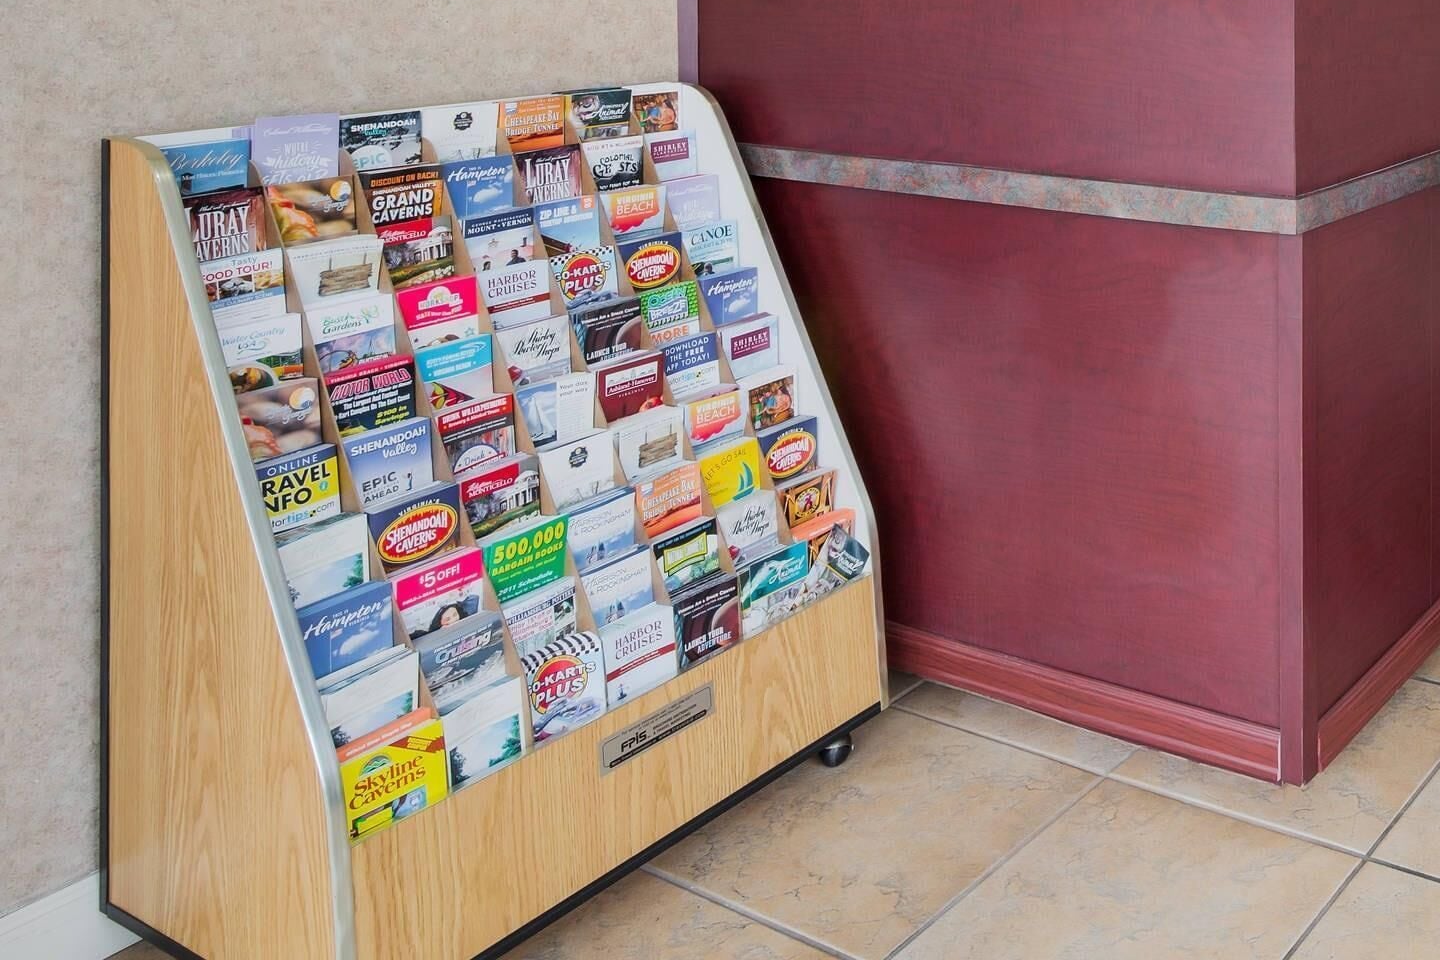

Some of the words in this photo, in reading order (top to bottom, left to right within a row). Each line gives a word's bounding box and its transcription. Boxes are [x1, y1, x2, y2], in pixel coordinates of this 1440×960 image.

[351, 118, 417, 133] SHENANDOAH
[547, 110, 560, 123] BAY
[447, 166, 505, 183] Hampton
[525, 158, 571, 188] LURAY
[372, 189, 434, 211] GRAND
[616, 200, 654, 215] BEACH
[371, 203, 433, 224] CAVERNS
[467, 224, 497, 235] MOUNT
[501, 216, 532, 228] VERNON
[690, 224, 733, 246] CANOE
[196, 234, 249, 262] AVERNS
[231, 255, 258, 267] Tasty
[236, 261, 273, 276] TOUR!
[630, 251, 674, 276] SHENANDOAH
[488, 270, 537, 288] HARBOR
[636, 264, 666, 280] CAVERNS
[488, 279, 537, 299] CRUISES
[564, 275, 604, 294] PLUS
[708, 278, 753, 296] Hampton
[322, 319, 362, 335] Gardens
[651, 325, 689, 345] MORE
[665, 336, 710, 357] DOWNLOAD
[669, 352, 683, 363] THE
[685, 345, 705, 359] FREE
[665, 362, 680, 373] APP
[681, 353, 710, 368] TODAY!
[330, 377, 370, 401] MOTOR
[372, 368, 412, 390] WORLD
[696, 404, 736, 424] BEACH
[351, 425, 427, 457] SHENANDOAH
[383, 441, 418, 459] Valley
[720, 454, 733, 466] GO
[769, 438, 809, 467] SHENANDOAH
[775, 452, 802, 470] CAVERNS
[267, 453, 319, 477] ONLINE
[262, 463, 331, 497] RAVEL
[362, 471, 398, 493] EPIC
[468, 478, 513, 499] MONTICELLO
[681, 479, 696, 492] BAY
[264, 487, 313, 513] NFO
[363, 485, 400, 504] AHEAD
[385, 510, 448, 551] SHENANDOAH
[395, 529, 437, 554] CAVERNS
[492, 520, 565, 565] 500,000
[491, 554, 533, 577] BARGAIN
[535, 541, 563, 560] BOOKS
[418, 570, 436, 588] $5
[437, 562, 461, 581] OFF!
[303, 601, 384, 641] Hampton
[615, 620, 663, 650] HARBOR
[615, 630, 663, 661] CRUISES
[684, 634, 707, 653] LAUNCH
[707, 626, 724, 641] YOUR
[697, 630, 732, 654] ADVENTURE
[535, 677, 585, 709] PLUS
[354, 755, 423, 797] Skyline
[349, 766, 427, 810] Caverns
